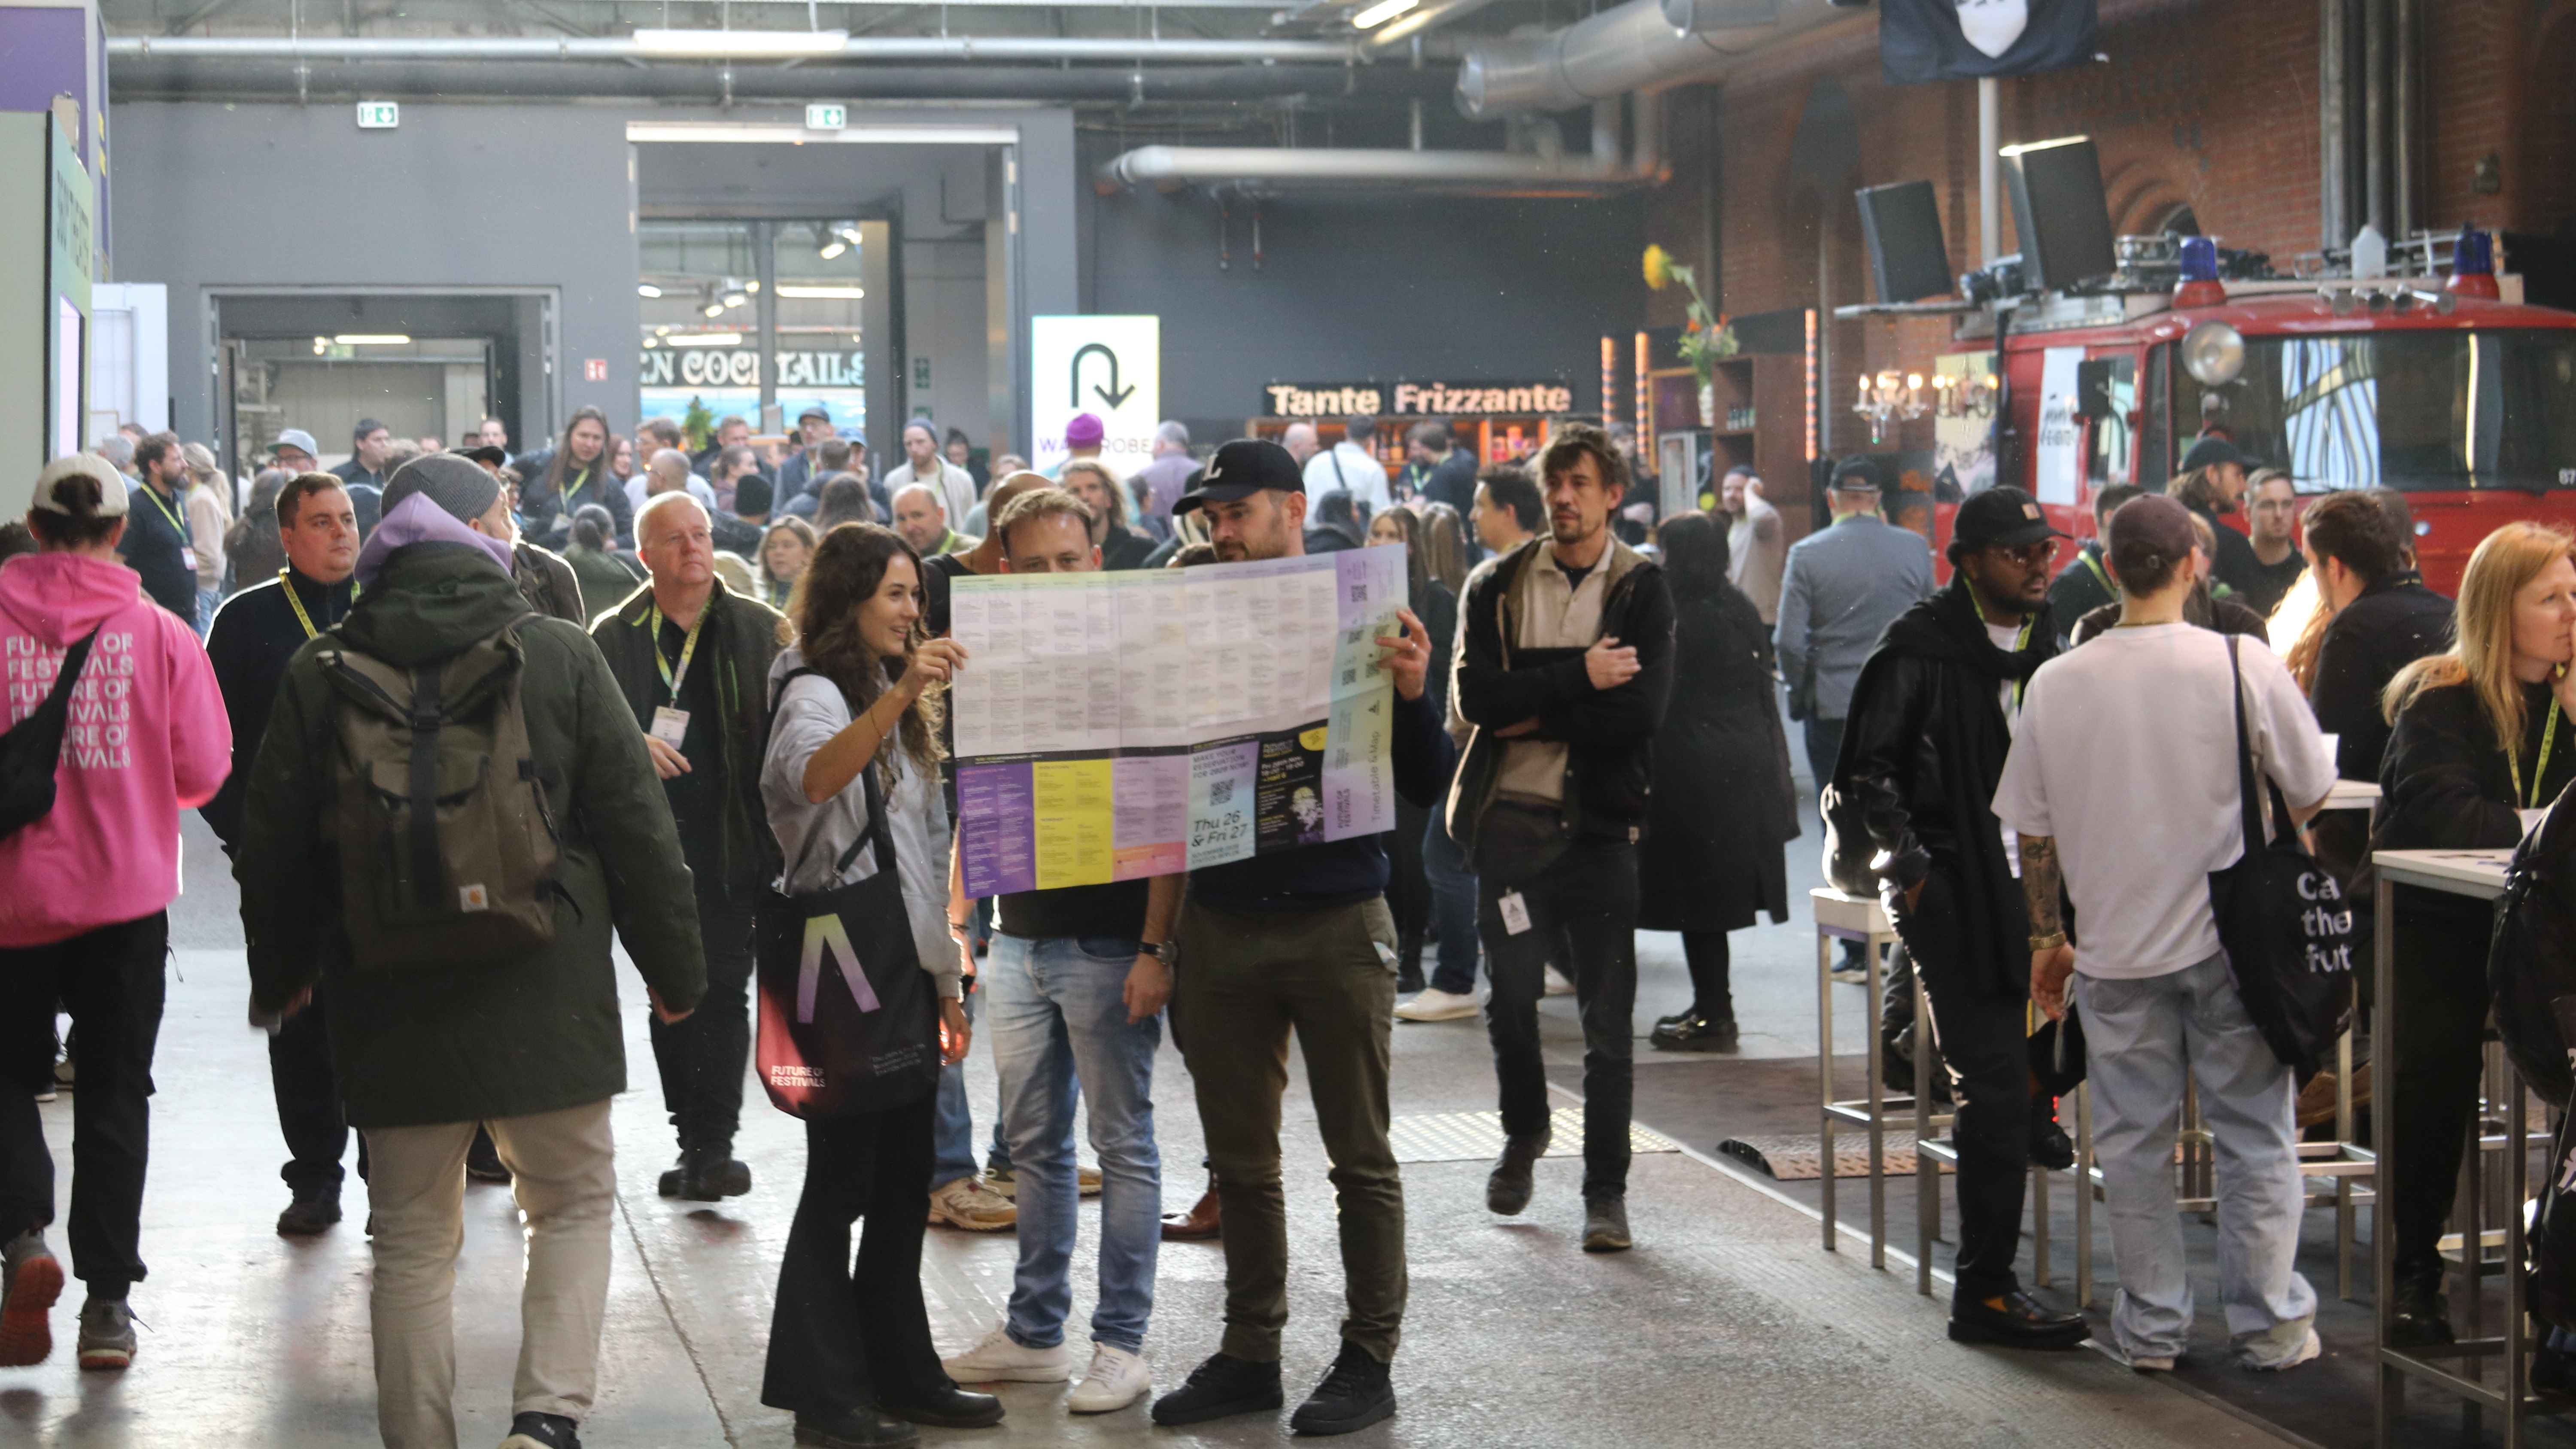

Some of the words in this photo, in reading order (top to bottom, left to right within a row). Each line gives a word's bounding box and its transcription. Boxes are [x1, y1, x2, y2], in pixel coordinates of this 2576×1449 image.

[1267, 385, 1381, 416] Tante
[1394, 382, 1572, 415] Frizzante
[103, 632, 133, 653] OF
[9, 678, 98, 703] FUTRE
[104, 678, 132, 700] OF
[1368, 731, 1381, 753] Map
[1370, 766, 1381, 823] Timetable
[1194, 818, 1220, 832] Thu
[1223, 810, 1241, 826] 26
[1191, 835, 1204, 847] &
[1207, 828, 1227, 844] Fri
[1230, 823, 1248, 839] 27
[2301, 905, 2352, 937] the
[770, 1076, 826, 1088] FESTIVALS
[772, 1065, 812, 1077] FUTURE
[813, 1067, 825, 1077] OF
